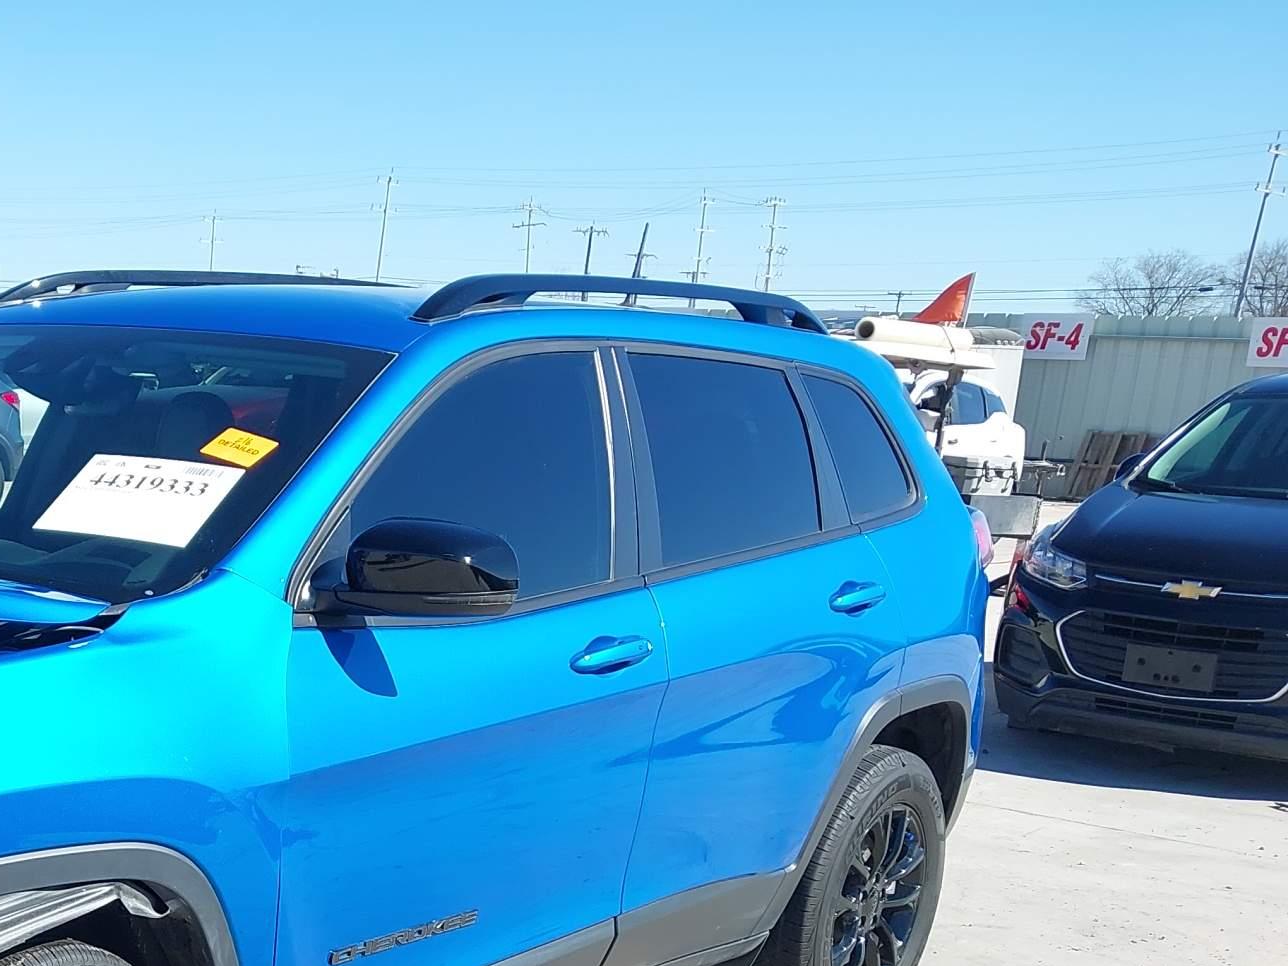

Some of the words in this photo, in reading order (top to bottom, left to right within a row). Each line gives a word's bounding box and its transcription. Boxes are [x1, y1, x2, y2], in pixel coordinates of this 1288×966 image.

[1026, 321, 1084, 351] SF-4
[217, 438, 260, 456] DETAILED
[90, 472, 209, 497] 44319333
